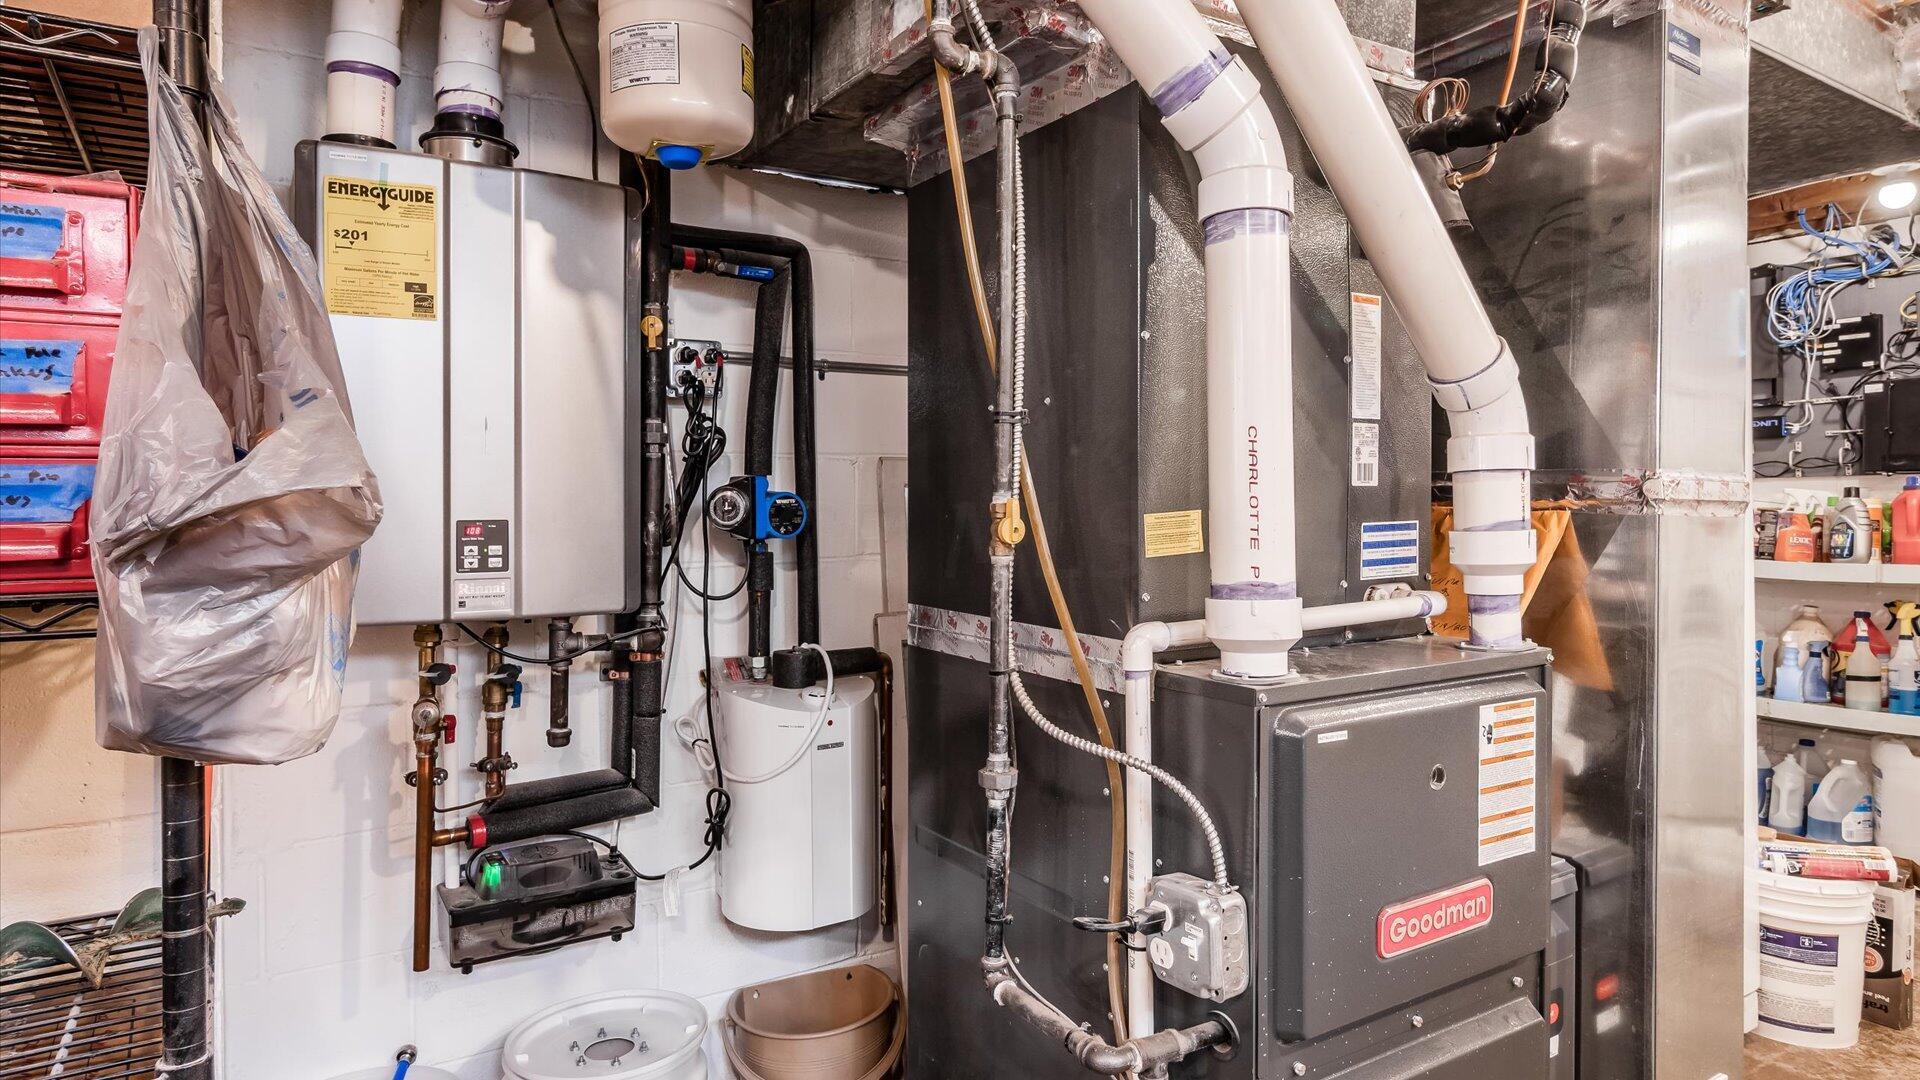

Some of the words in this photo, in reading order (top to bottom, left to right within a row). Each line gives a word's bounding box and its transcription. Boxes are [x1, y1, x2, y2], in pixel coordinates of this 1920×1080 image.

[1030, 85, 1043, 98] 3M
[328, 181, 434, 205] ENERGYGUIDE
[386, 221, 400, 229] Energy
[333, 228, 368, 242] $201
[1247, 425, 1260, 551] CHARLOTTE
[459, 582, 505, 595] Rinnai
[976, 619, 988, 635] 3M
[1040, 630, 1054, 648] 3M
[1389, 895, 1487, 944] Goodman
